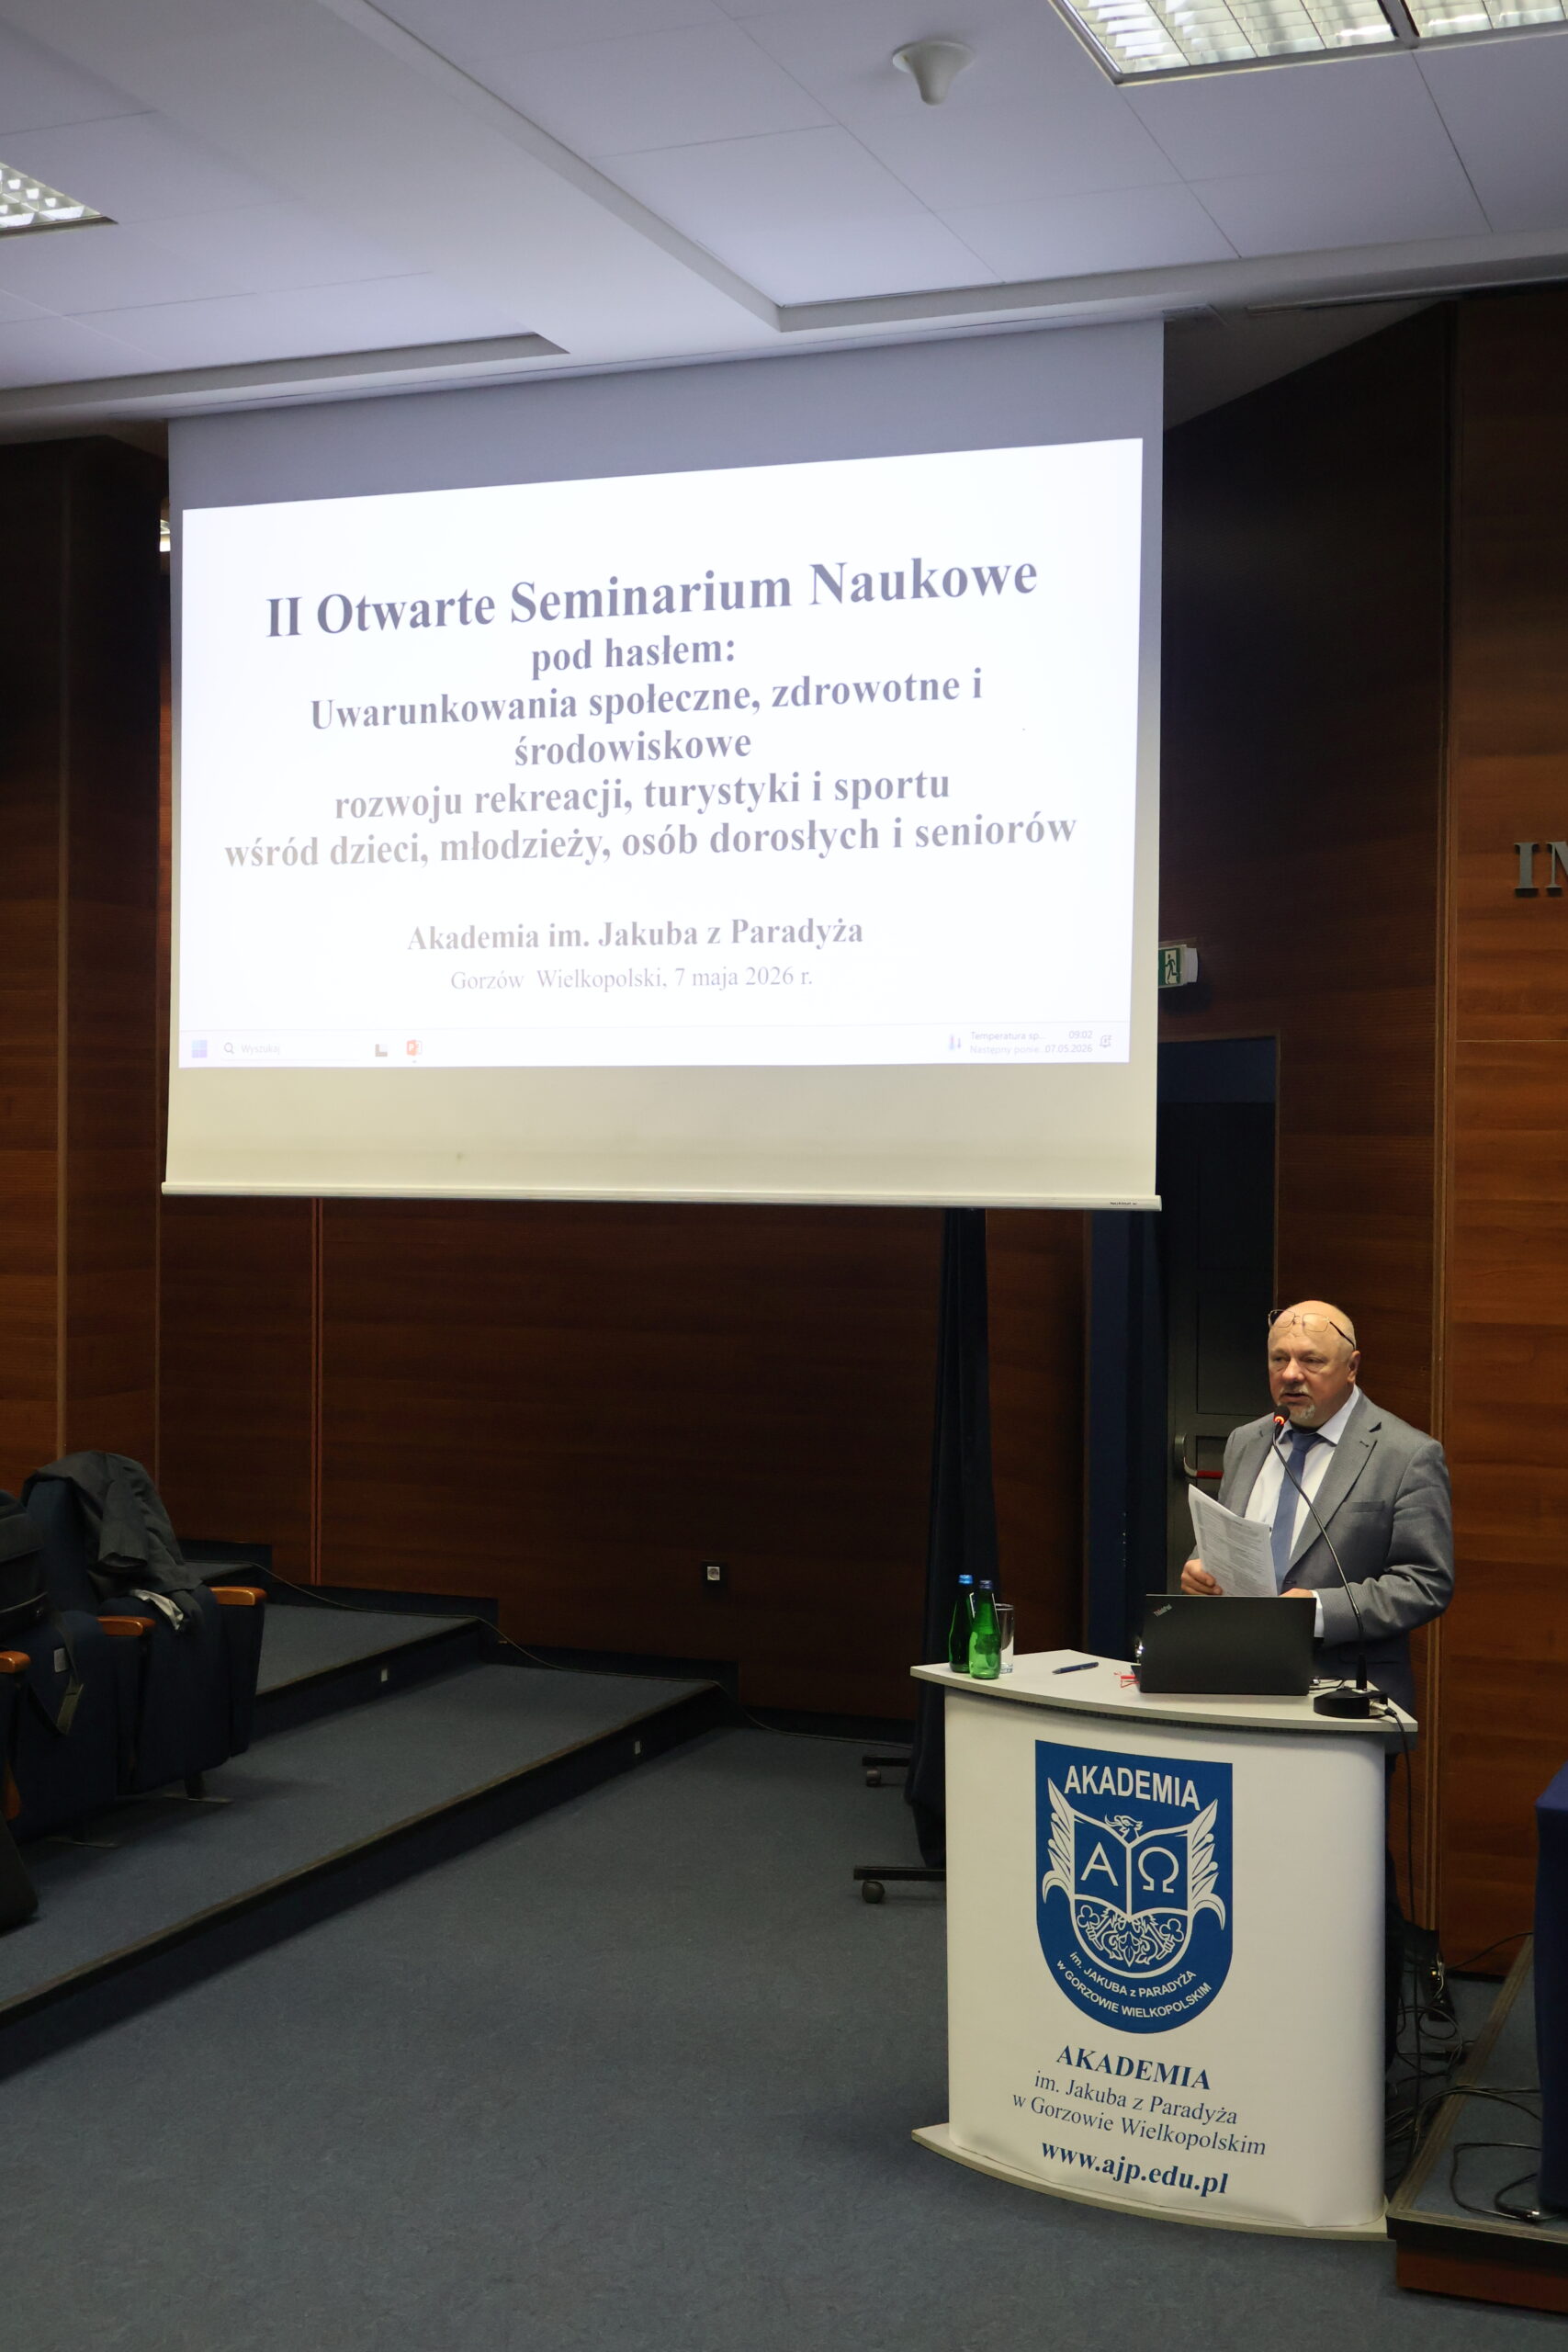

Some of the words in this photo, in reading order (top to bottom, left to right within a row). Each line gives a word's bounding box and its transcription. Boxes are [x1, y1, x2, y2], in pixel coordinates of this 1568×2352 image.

[266, 596, 302, 638] II
[317, 589, 496, 635] Otwarte
[511, 570, 792, 624] Seminarium
[809, 557, 1037, 605] Naukowe
[532, 639, 592, 682] pod
[604, 634, 735, 668] hasłem:
[310, 687, 578, 729] Uwarunkowania
[589, 683, 761, 725] społeczne,
[771, 673, 960, 707] zdrowotne
[972, 666, 982, 699] i
[514, 729, 751, 766] środowiskowe
[335, 785, 462, 824] rozwoju
[475, 777, 633, 819] rekreacji,
[644, 771, 800, 815] turystyki
[812, 770, 821, 802] i
[834, 771, 949, 810] sportu
[224, 836, 319, 867] wśród
[330, 831, 429, 868] dzieci,
[440, 828, 611, 866] młodzieży,
[622, 823, 698, 856] osób
[709, 818, 879, 860] dorosłych
[893, 816, 902, 848] i
[915, 810, 1077, 848] seniorów
[407, 922, 539, 950] Akademia
[548, 922, 590, 948] im.
[597, 920, 698, 947] Jakuba
[706, 926, 721, 944] z
[731, 917, 863, 951] Paradyża
[450, 969, 525, 990] Gorzów
[536, 967, 668, 993] Wielkopolski,
[673, 967, 686, 987] 7
[692, 966, 739, 991] maja
[745, 966, 795, 986] 2026
[800, 971, 813, 986] r.
[241, 1043, 280, 1056] Wyszukaj
[970, 1031, 1026, 1042] Temperatura
[1044, 1045, 1093, 1054] 07.05.2026
[1068, 1030, 1093, 1040] 09:02
[1064, 1765, 1201, 1811] AKADEMIA
[1056, 1959, 1066, 1971] w
[1064, 1969, 1119, 2013] GORZOWIE
[1122, 1982, 1212, 2018] WIELKOPOLSKIM
[1069, 1951, 1083, 1970] im.
[1083, 1966, 1127, 1996] JAKUBA
[1130, 1988, 1137, 1997] z
[1139, 1970, 1197, 1997] PARADYŻA
[1056, 2045, 1211, 2090] AKADEMIA
[1034, 2070, 1059, 2093] im.
[1066, 2079, 1126, 2108] Jakuba
[1133, 2098, 1144, 2110] z
[1149, 2096, 1238, 2125] Paradyża
[1012, 2094, 1026, 2109] w
[1031, 2096, 1113, 2132] Gorzowie
[1122, 2117, 1266, 2155] Wielkopolskim
[1042, 2142, 1229, 2198] www.ajp.edu.pl
